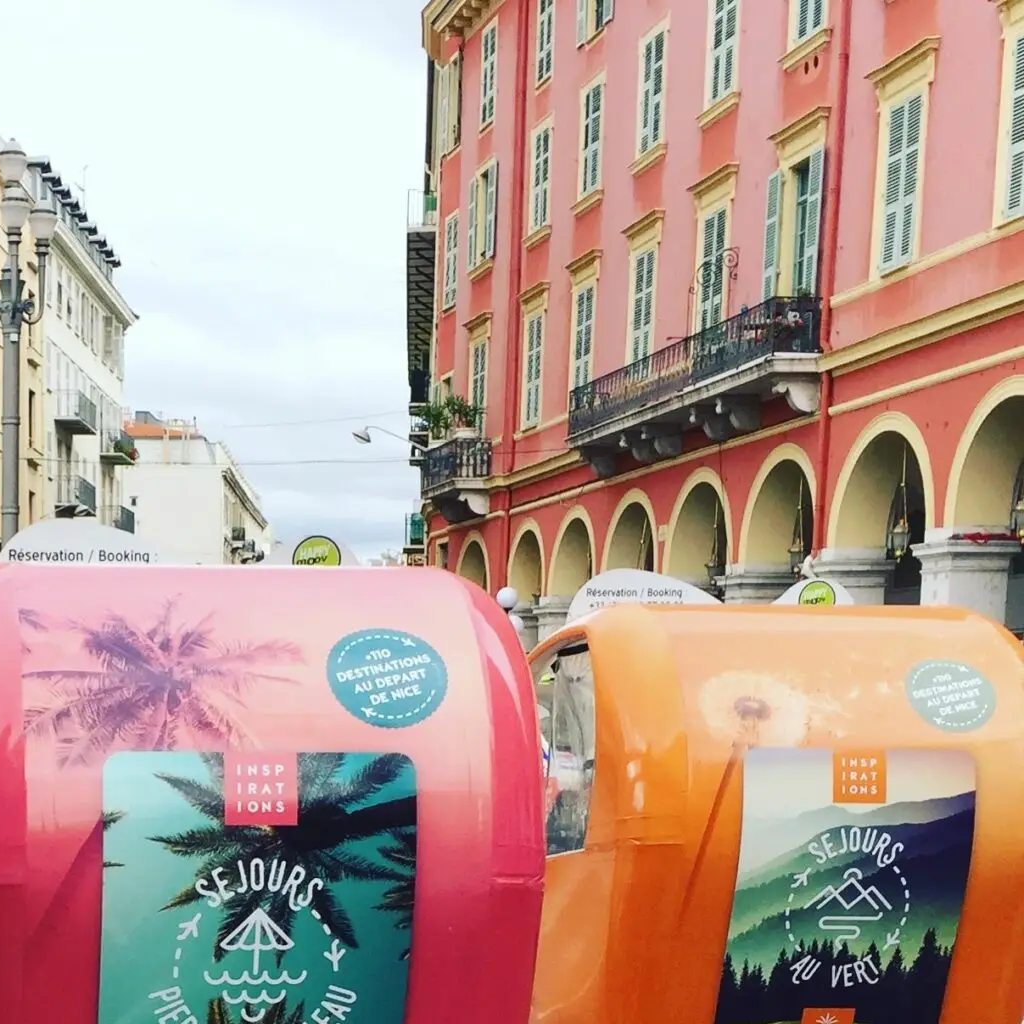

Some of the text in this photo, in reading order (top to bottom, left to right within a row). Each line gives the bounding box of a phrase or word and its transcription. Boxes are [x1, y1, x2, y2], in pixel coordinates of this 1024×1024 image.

[8, 548, 84, 562] Réservation
[98, 549, 150, 564] Booking
[586, 587, 638, 598] Réservation
[647, 587, 683, 599] Booking
[336, 653, 431, 682] DESTINATIONS
[354, 668, 427, 694] AU DEPART
[369, 684, 422, 705] DE NICE
[841, 757, 877, 768] INSP
[236, 764, 285, 777] INSP
[841, 771, 878, 781] IRAT
[236, 782, 285, 795] IRAT
[841, 784, 878, 795] IONS
[236, 800, 285, 813] IONS
[808, 826, 904, 868] SEJOURS
[194, 857, 324, 912] SEJOURS
[789, 954, 881, 988] AU VERT
